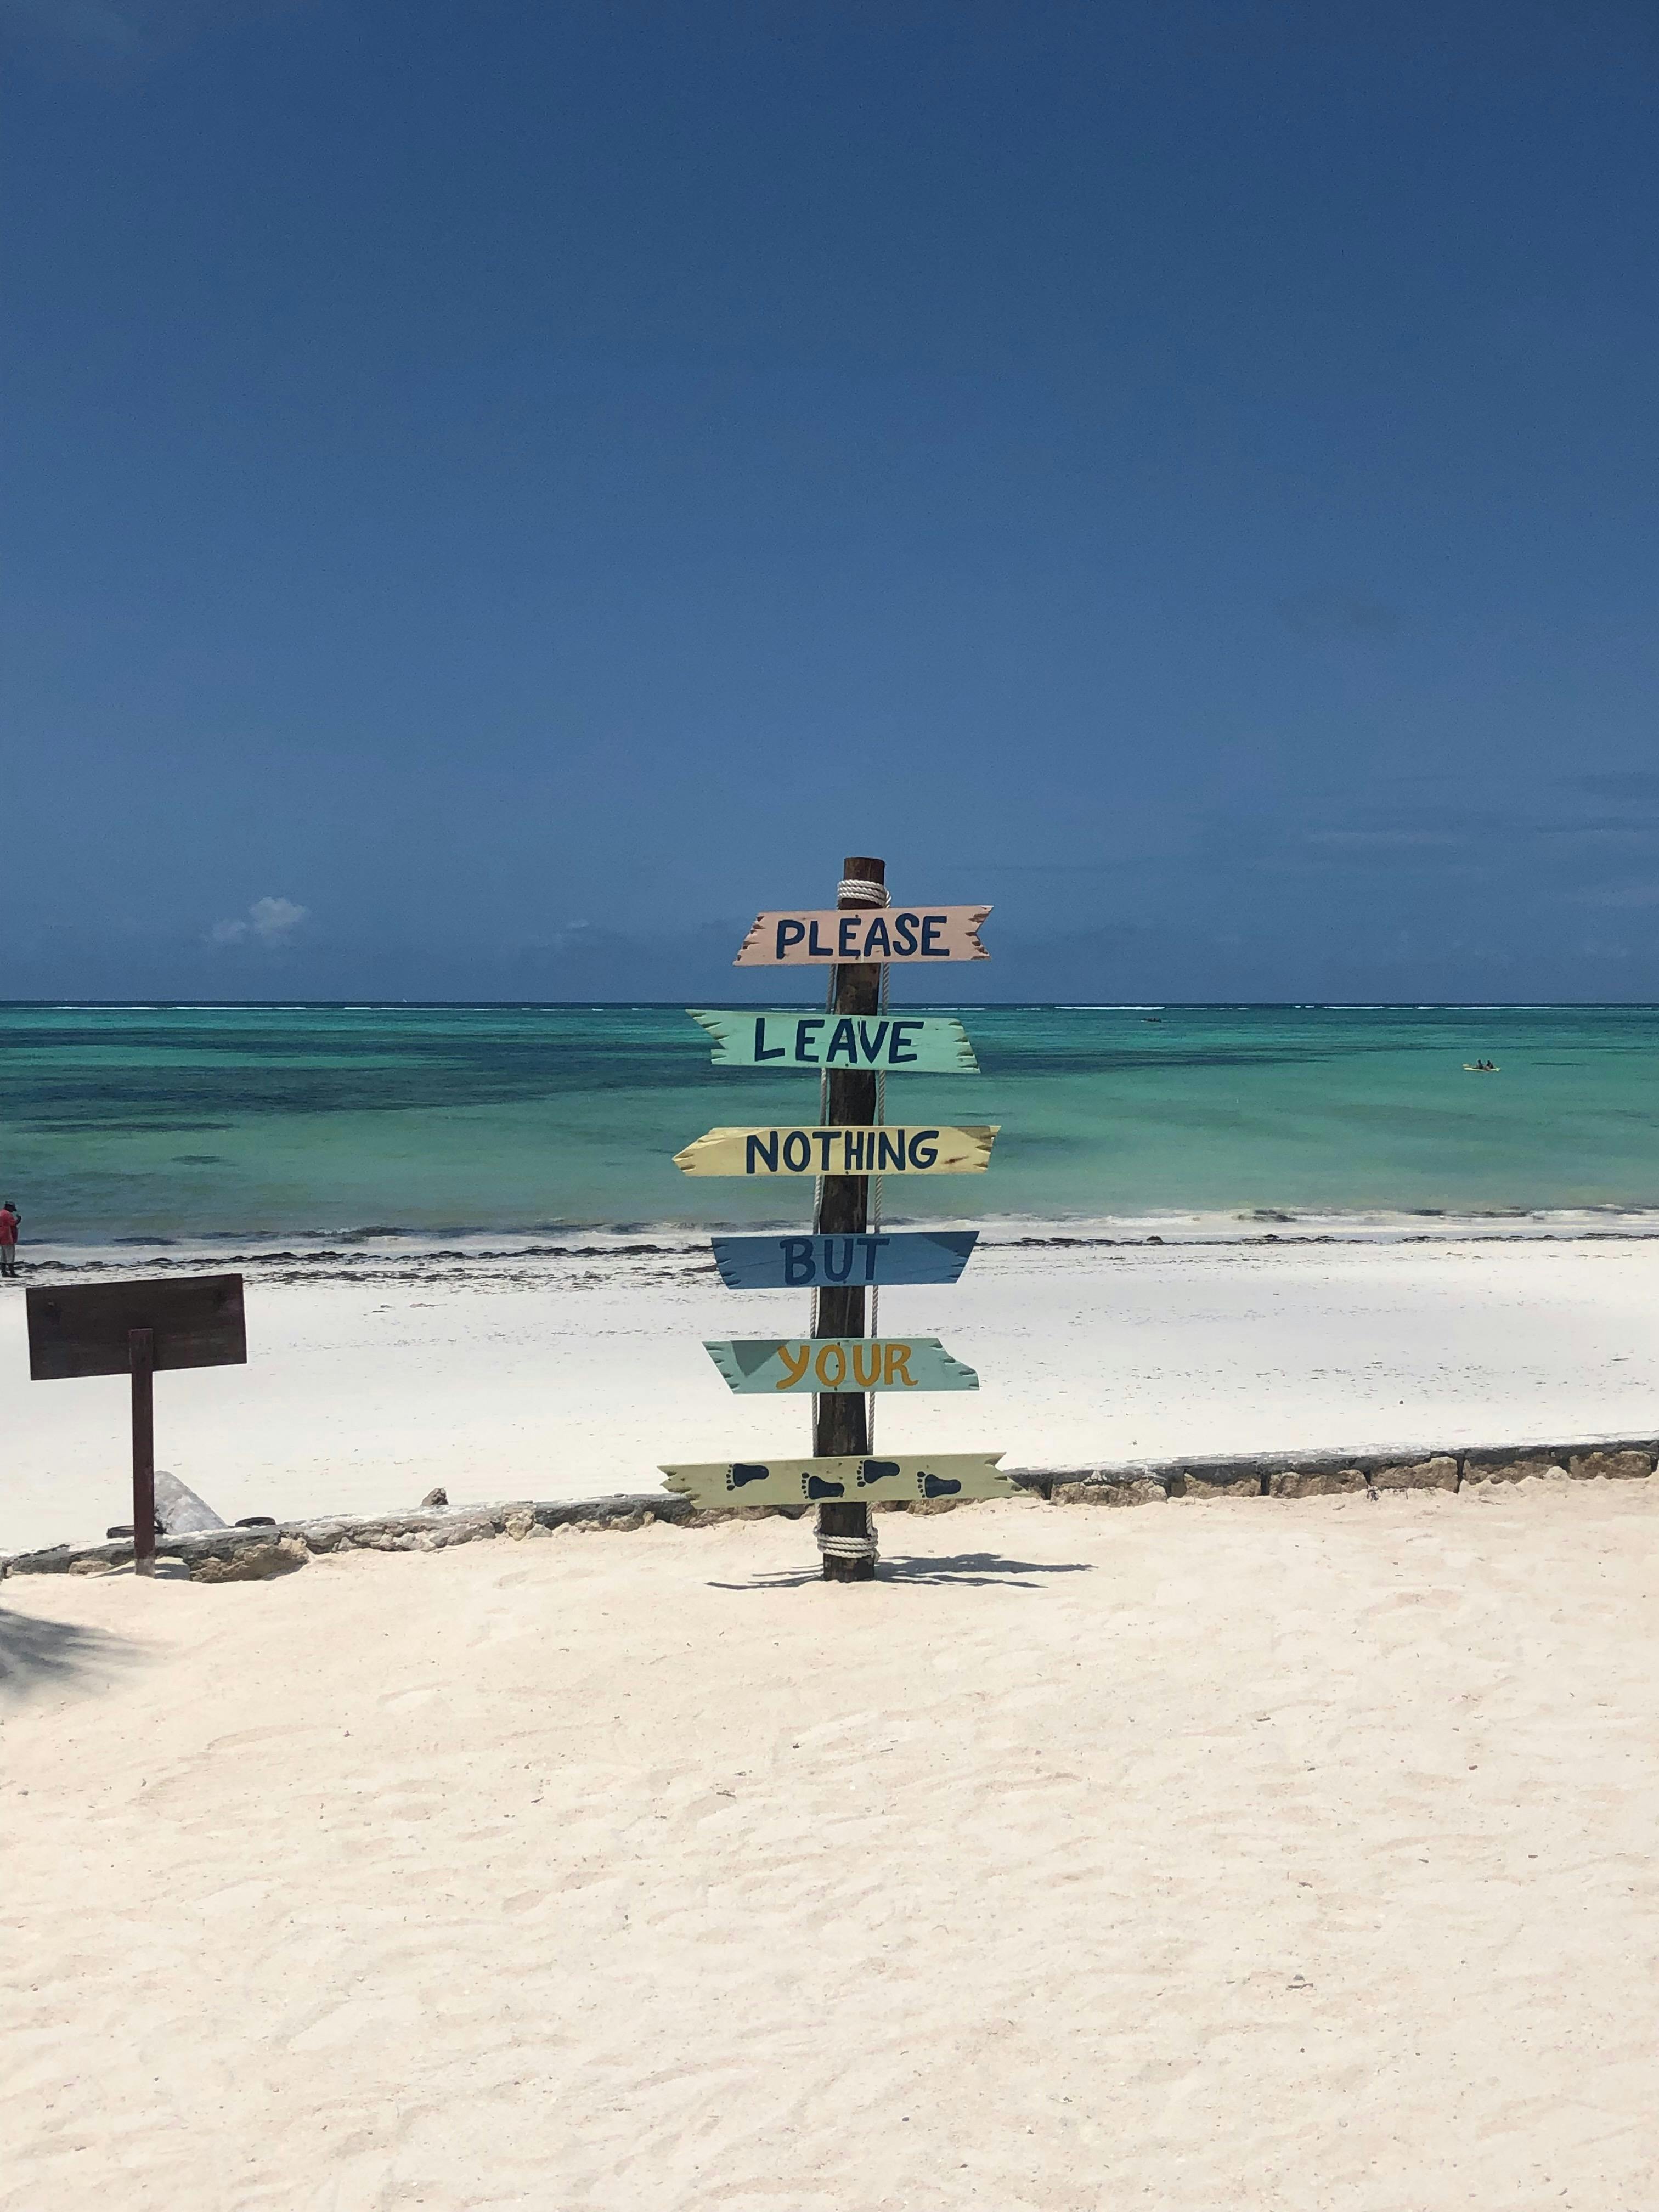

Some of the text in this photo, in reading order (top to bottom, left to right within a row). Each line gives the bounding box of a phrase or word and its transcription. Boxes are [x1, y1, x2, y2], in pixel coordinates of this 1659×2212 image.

[776, 913, 951, 960] PLEASE
[754, 1017, 925, 1064] LEAVE
[746, 1129, 940, 1175] NOTHING
[779, 1237, 890, 1286] BUT
[775, 1342, 918, 1390] YOUR
